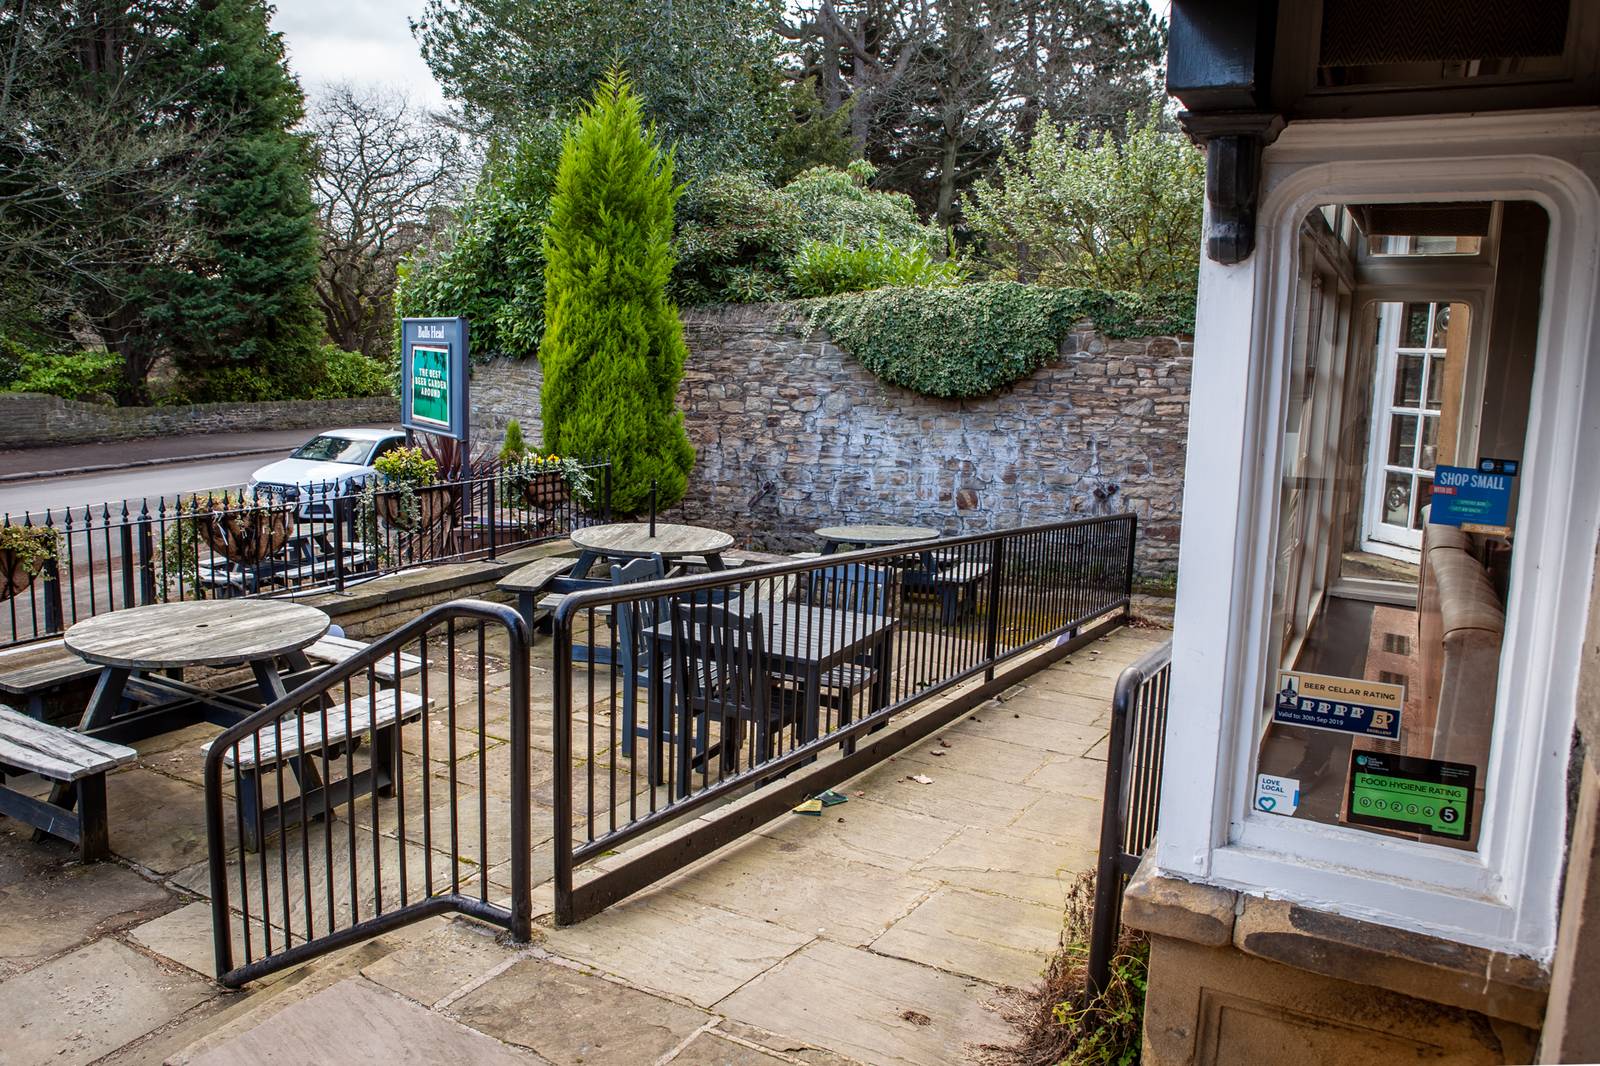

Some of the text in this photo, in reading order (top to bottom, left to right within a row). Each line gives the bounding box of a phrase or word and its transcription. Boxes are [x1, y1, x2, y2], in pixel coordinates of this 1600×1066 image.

[430, 325, 444, 338] Head
[419, 368, 441, 378] THE BEST
[415, 377, 447, 389] BEER GARDEN
[421, 387, 440, 398] AROUND
[1440, 472, 1504, 490] SHOP SMALL
[1304, 682, 1395, 700] BEER CELLAR RATING
[1278, 710, 1292, 719] Valid
[1302, 714, 1316, 722] 30th
[1316, 716, 1328, 724] Sep
[1328, 718, 1344, 726] 2019
[1375, 714, 1384, 725] 5
[1262, 778, 1280, 786] LOVE
[1360, 777, 1461, 798] FOOD HYGIENE RATING
[1261, 784, 1284, 793] LOCAL
[1443, 808, 1454, 822] 5
